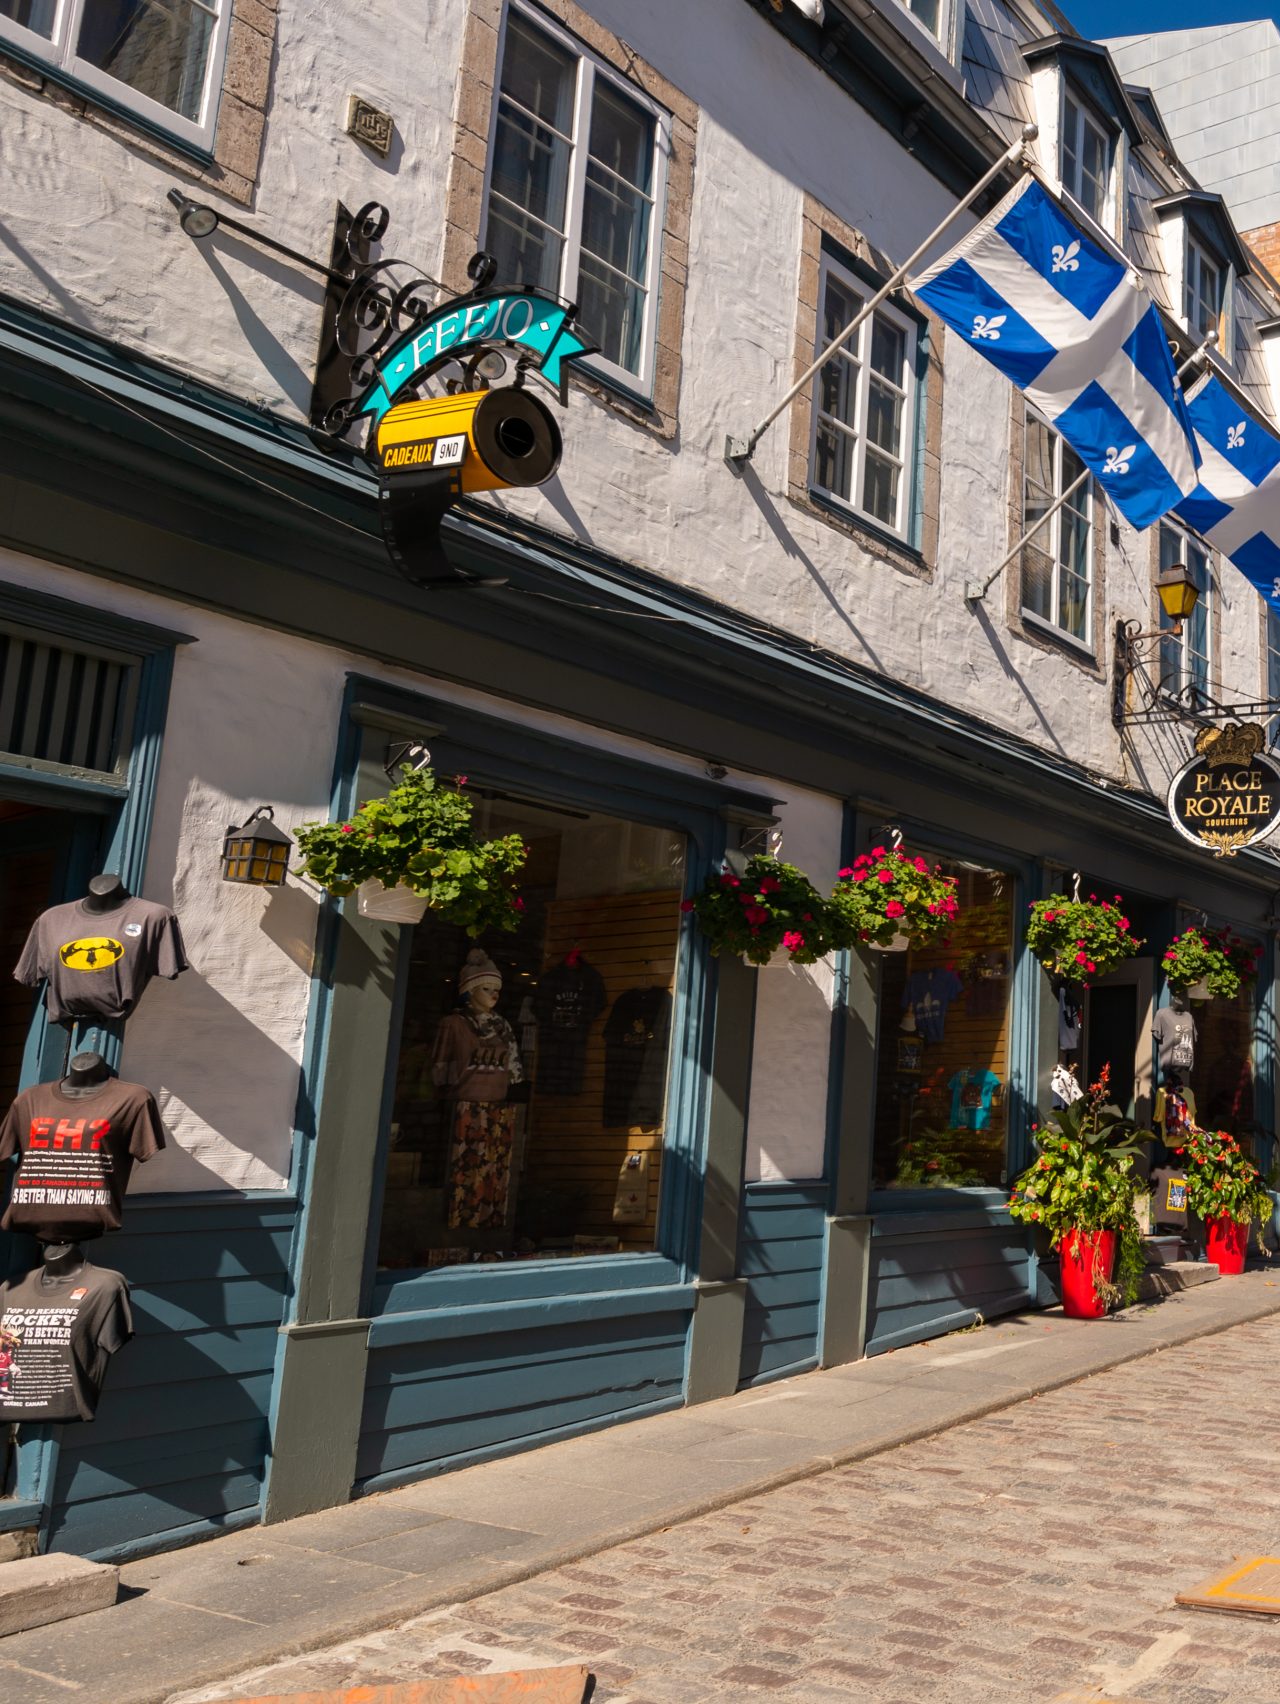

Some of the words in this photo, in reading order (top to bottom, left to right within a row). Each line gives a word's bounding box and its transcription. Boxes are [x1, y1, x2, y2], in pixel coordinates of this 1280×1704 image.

[411, 299, 534, 371] FEEJO
[384, 443, 434, 467] CADEAUX
[1194, 771, 1262, 793] PLACE
[1184, 795, 1270, 817] ROYALE
[1205, 817, 1249, 827] SOUVENIRS
[29, 1117, 110, 1150] EH?
[19, 1188, 46, 1204] BETTER
[46, 1189, 66, 1204] THAN
[66, 1189, 95, 1205] SAYING
[1, 1314, 77, 1327] HOCKEY
[24, 1327, 35, 1338] IS
[34, 1327, 72, 1338] BETTER
